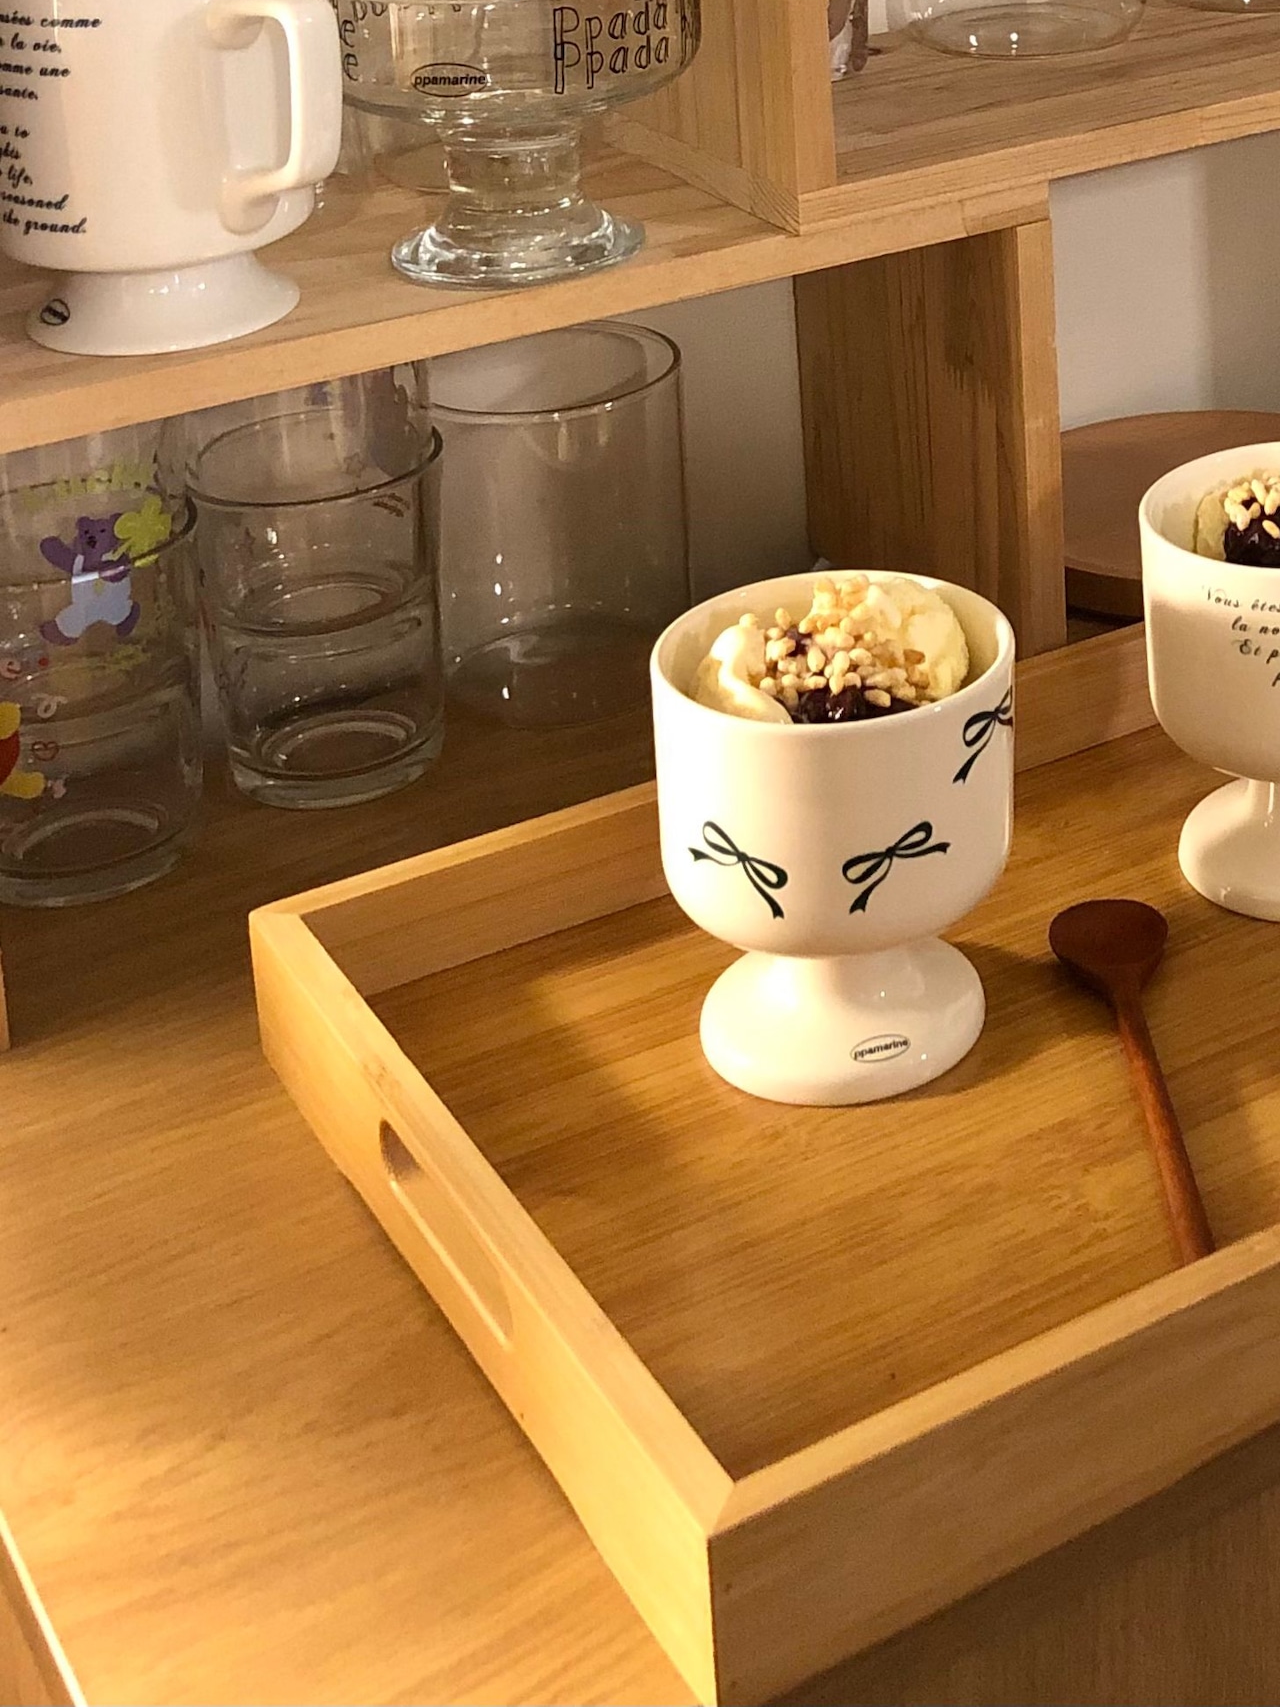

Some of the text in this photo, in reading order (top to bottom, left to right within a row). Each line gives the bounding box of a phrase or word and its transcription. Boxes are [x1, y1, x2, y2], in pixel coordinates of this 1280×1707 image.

[41, 18, 102, 28] comme
[10, 32, 27, 50] la
[39, 67, 71, 77] une
[414, 73, 486, 86] ppamarine
[15, 126, 30, 139] to
[1231, 616, 1250, 632] la
[1232, 639, 1262, 656] Et
[854, 1039, 908, 1061] ppamarine
